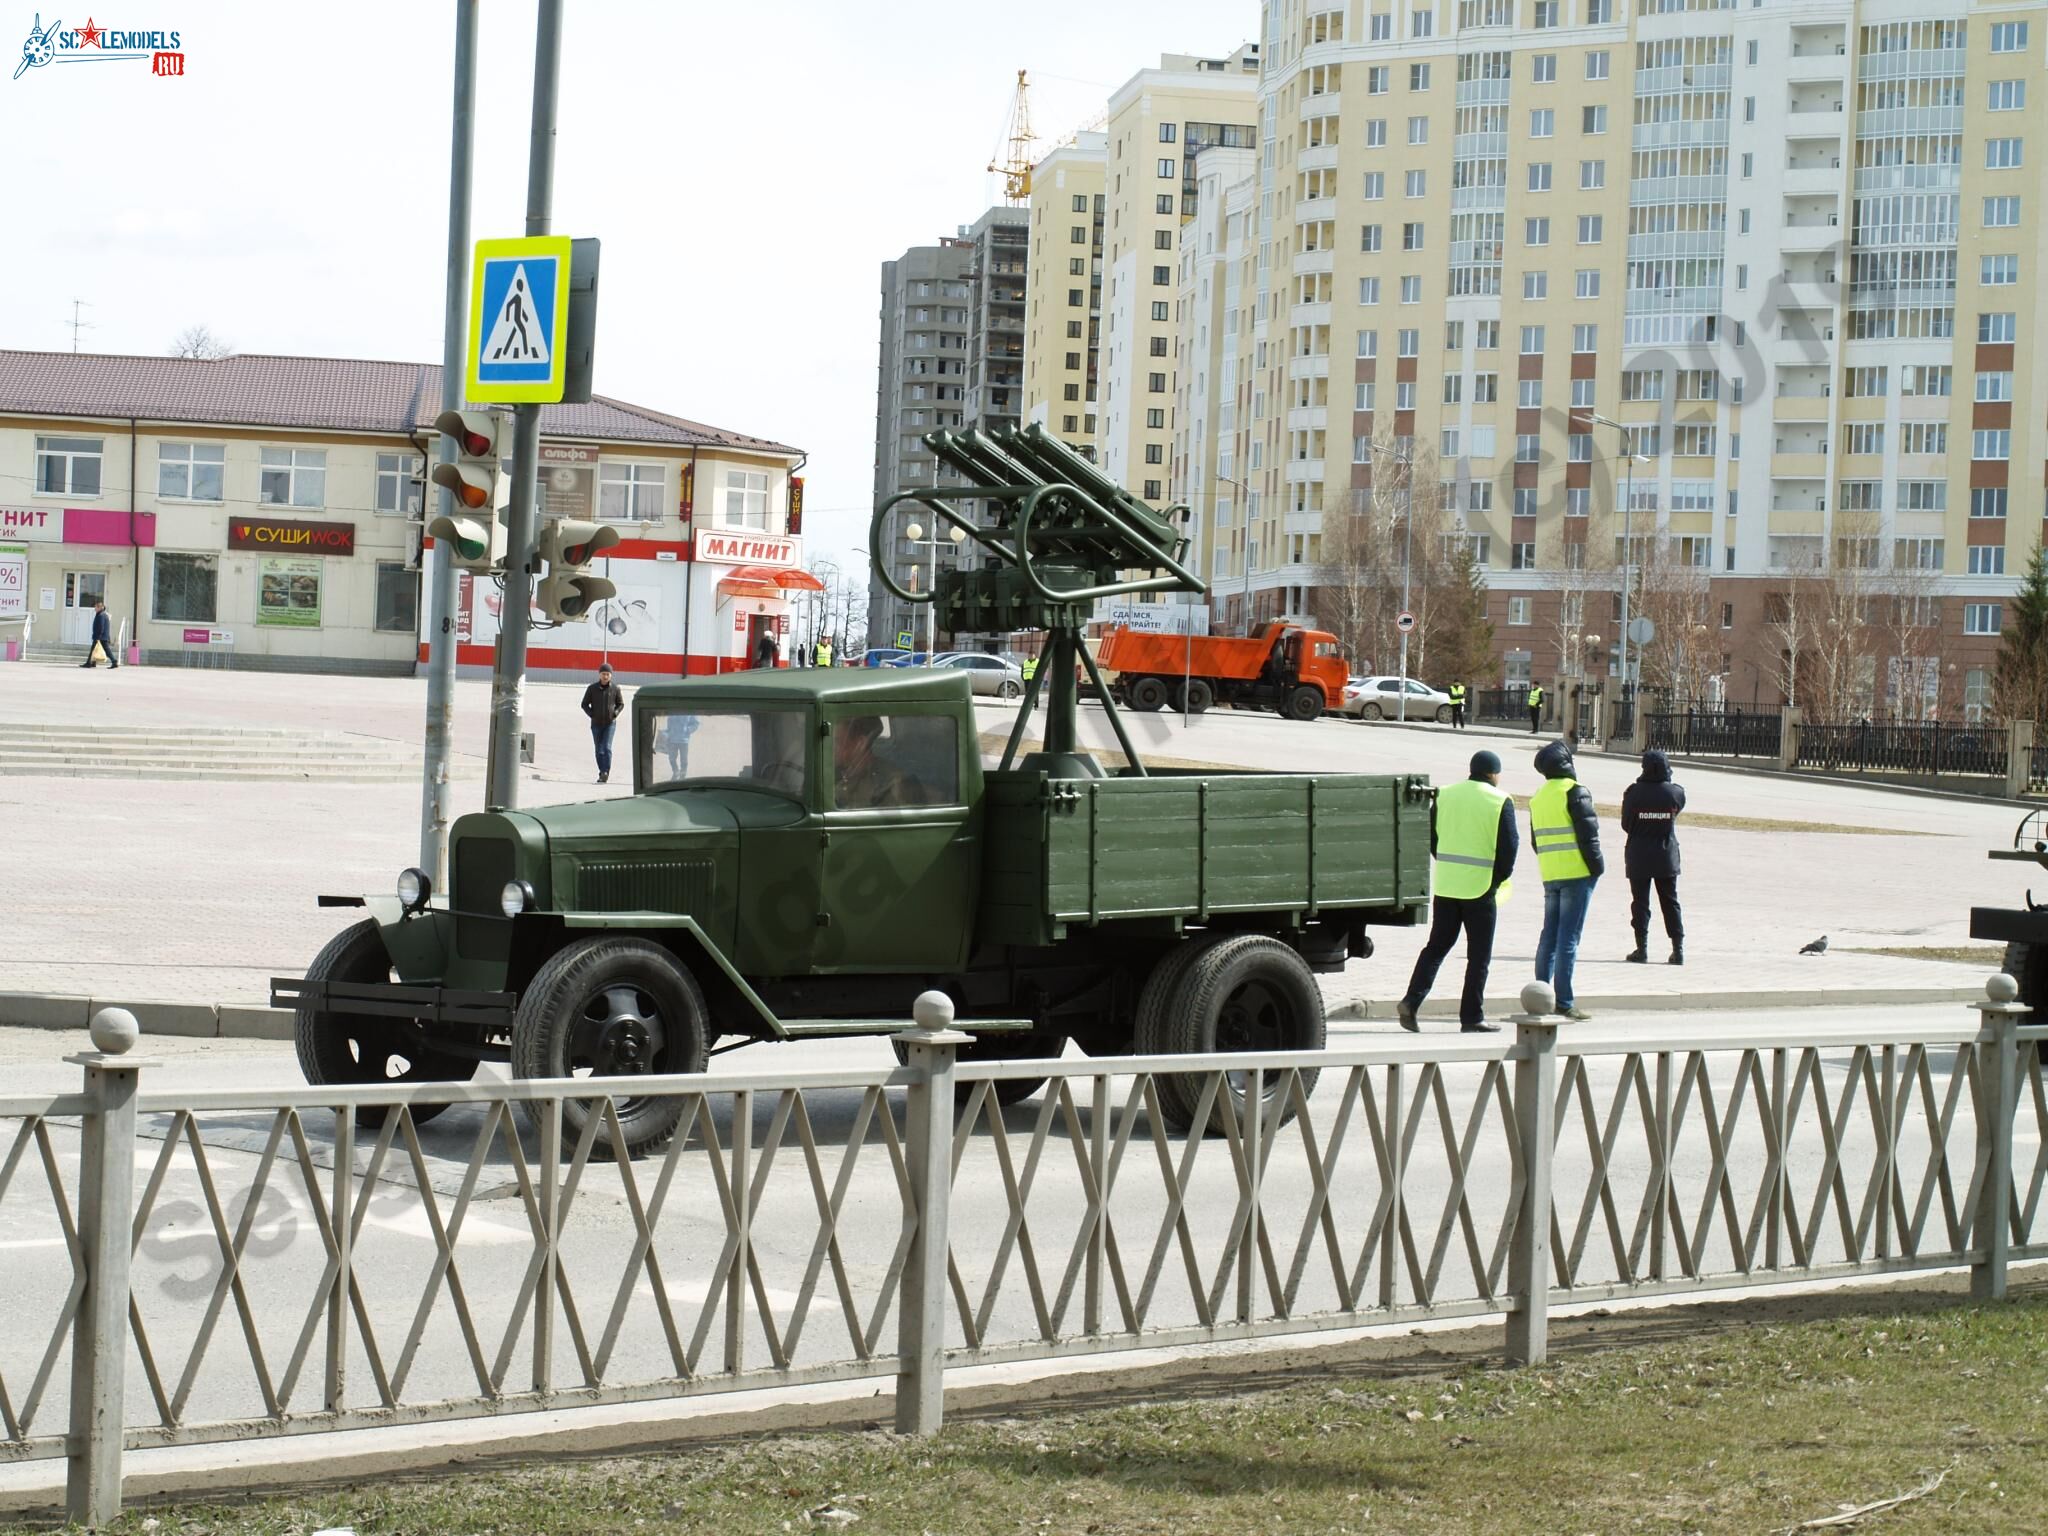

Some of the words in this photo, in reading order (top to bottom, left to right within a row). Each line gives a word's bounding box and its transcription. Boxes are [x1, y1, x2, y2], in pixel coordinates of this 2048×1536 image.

[544, 448, 588, 461] альфа
[707, 538, 791, 561] МАГНИТ
[1639, 812, 1671, 820] ПОЛИЦИЯ
